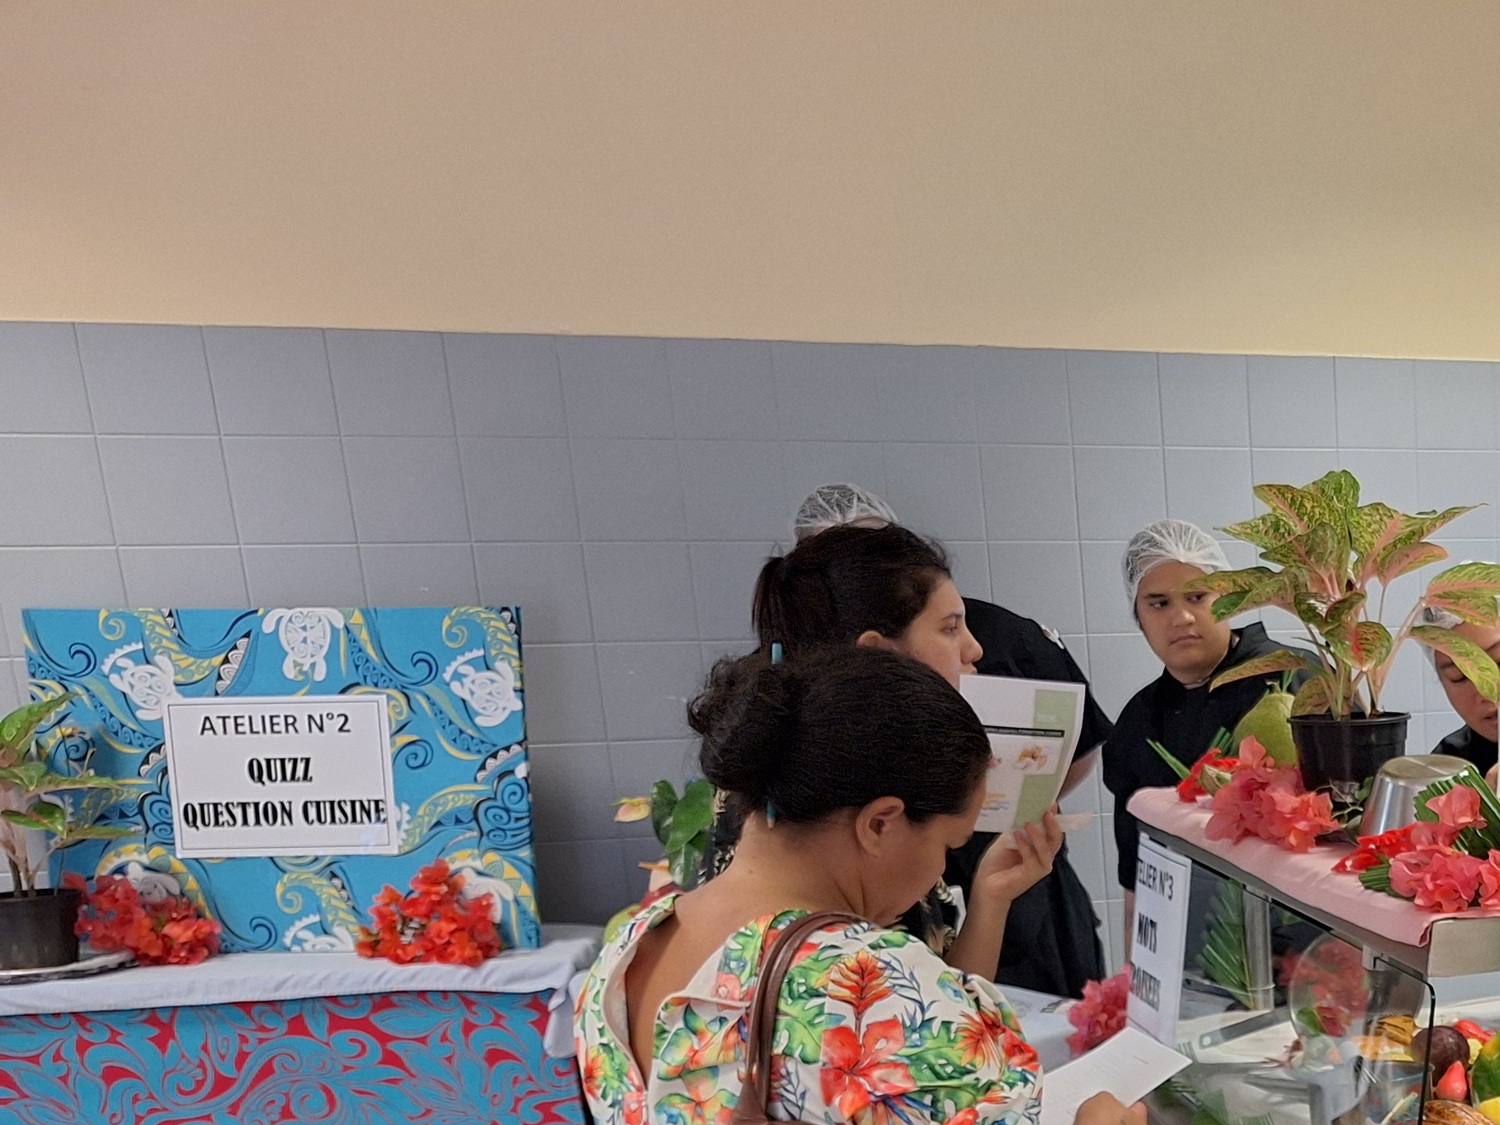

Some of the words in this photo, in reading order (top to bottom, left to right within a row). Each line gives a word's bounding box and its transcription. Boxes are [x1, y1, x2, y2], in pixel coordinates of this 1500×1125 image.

[200, 714, 299, 736] ATELIER
[308, 713, 351, 733] N°2
[248, 757, 313, 786] QUIZZ
[183, 801, 293, 831] QUESTION
[302, 799, 387, 826] CUISINE
